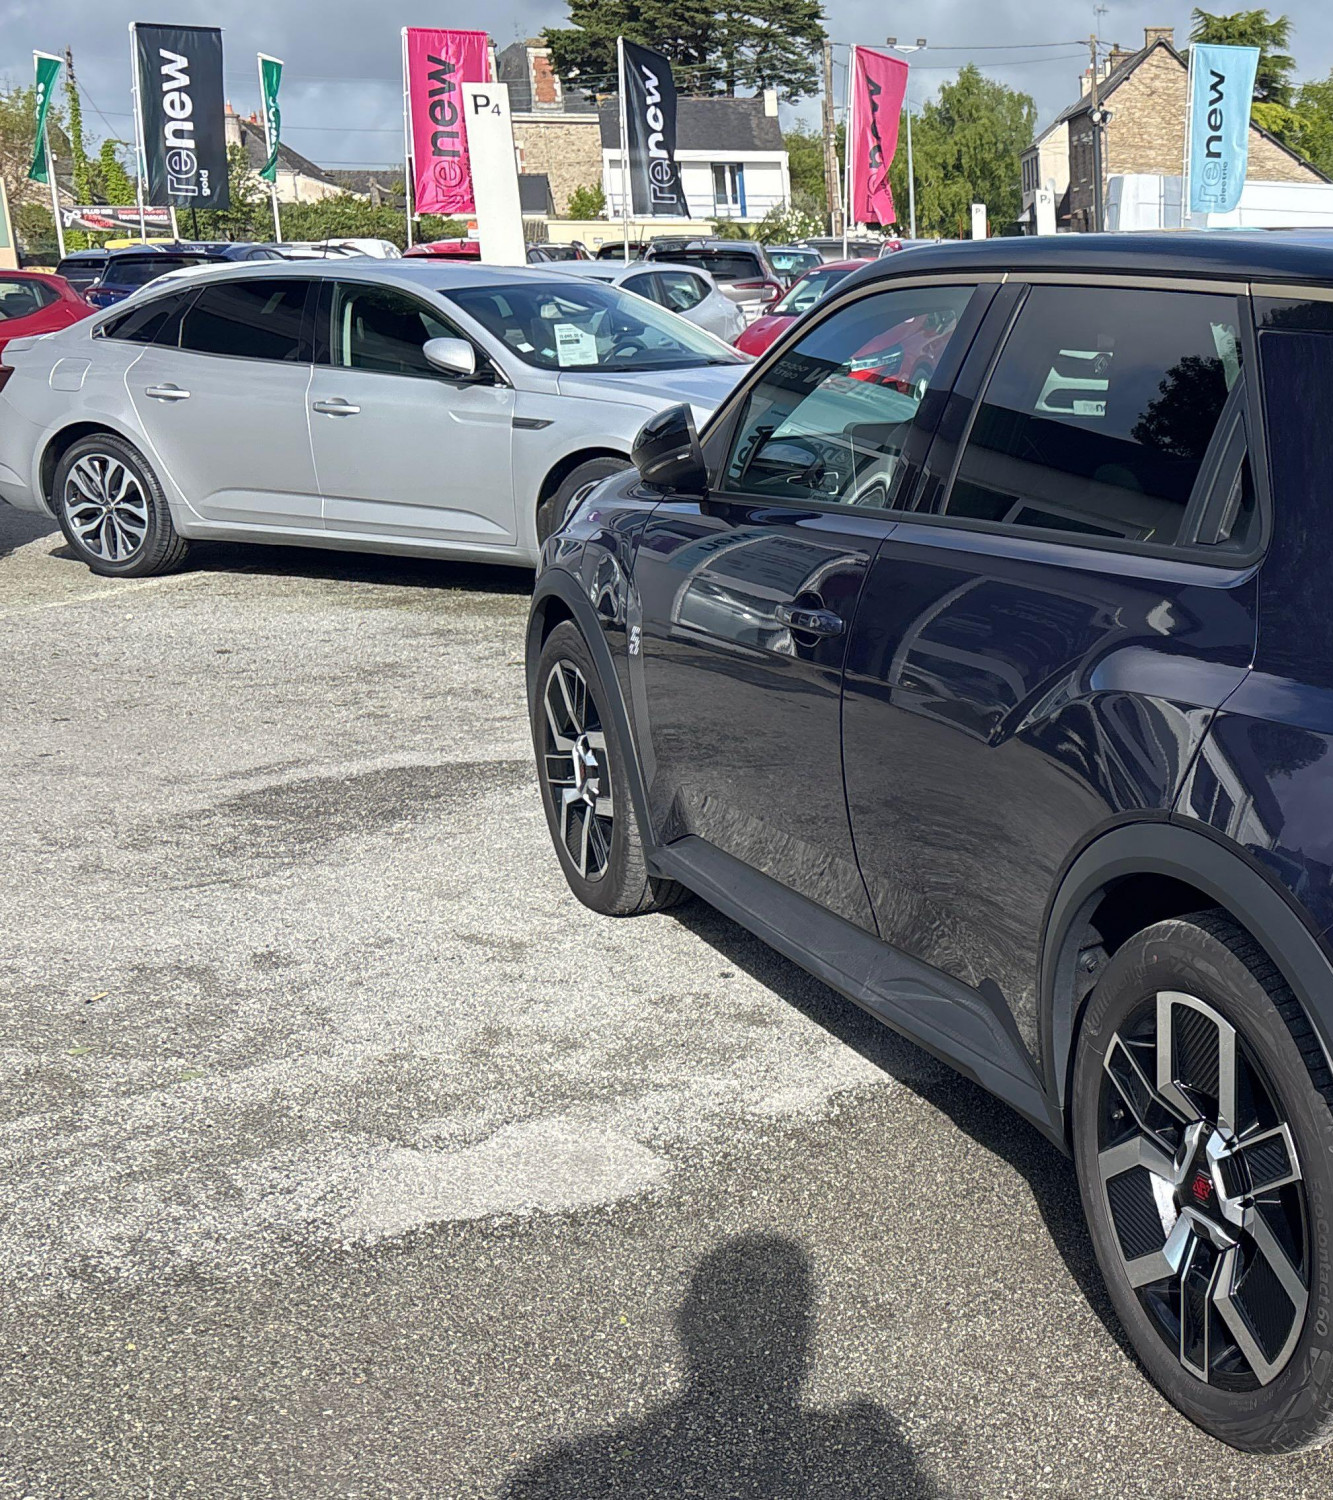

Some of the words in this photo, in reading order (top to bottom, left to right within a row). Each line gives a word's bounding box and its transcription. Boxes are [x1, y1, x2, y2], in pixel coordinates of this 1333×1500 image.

[159, 47, 198, 197] renew
[199, 169, 211, 197] gold
[427, 54, 465, 204] renew
[1198, 68, 1226, 204] renew
